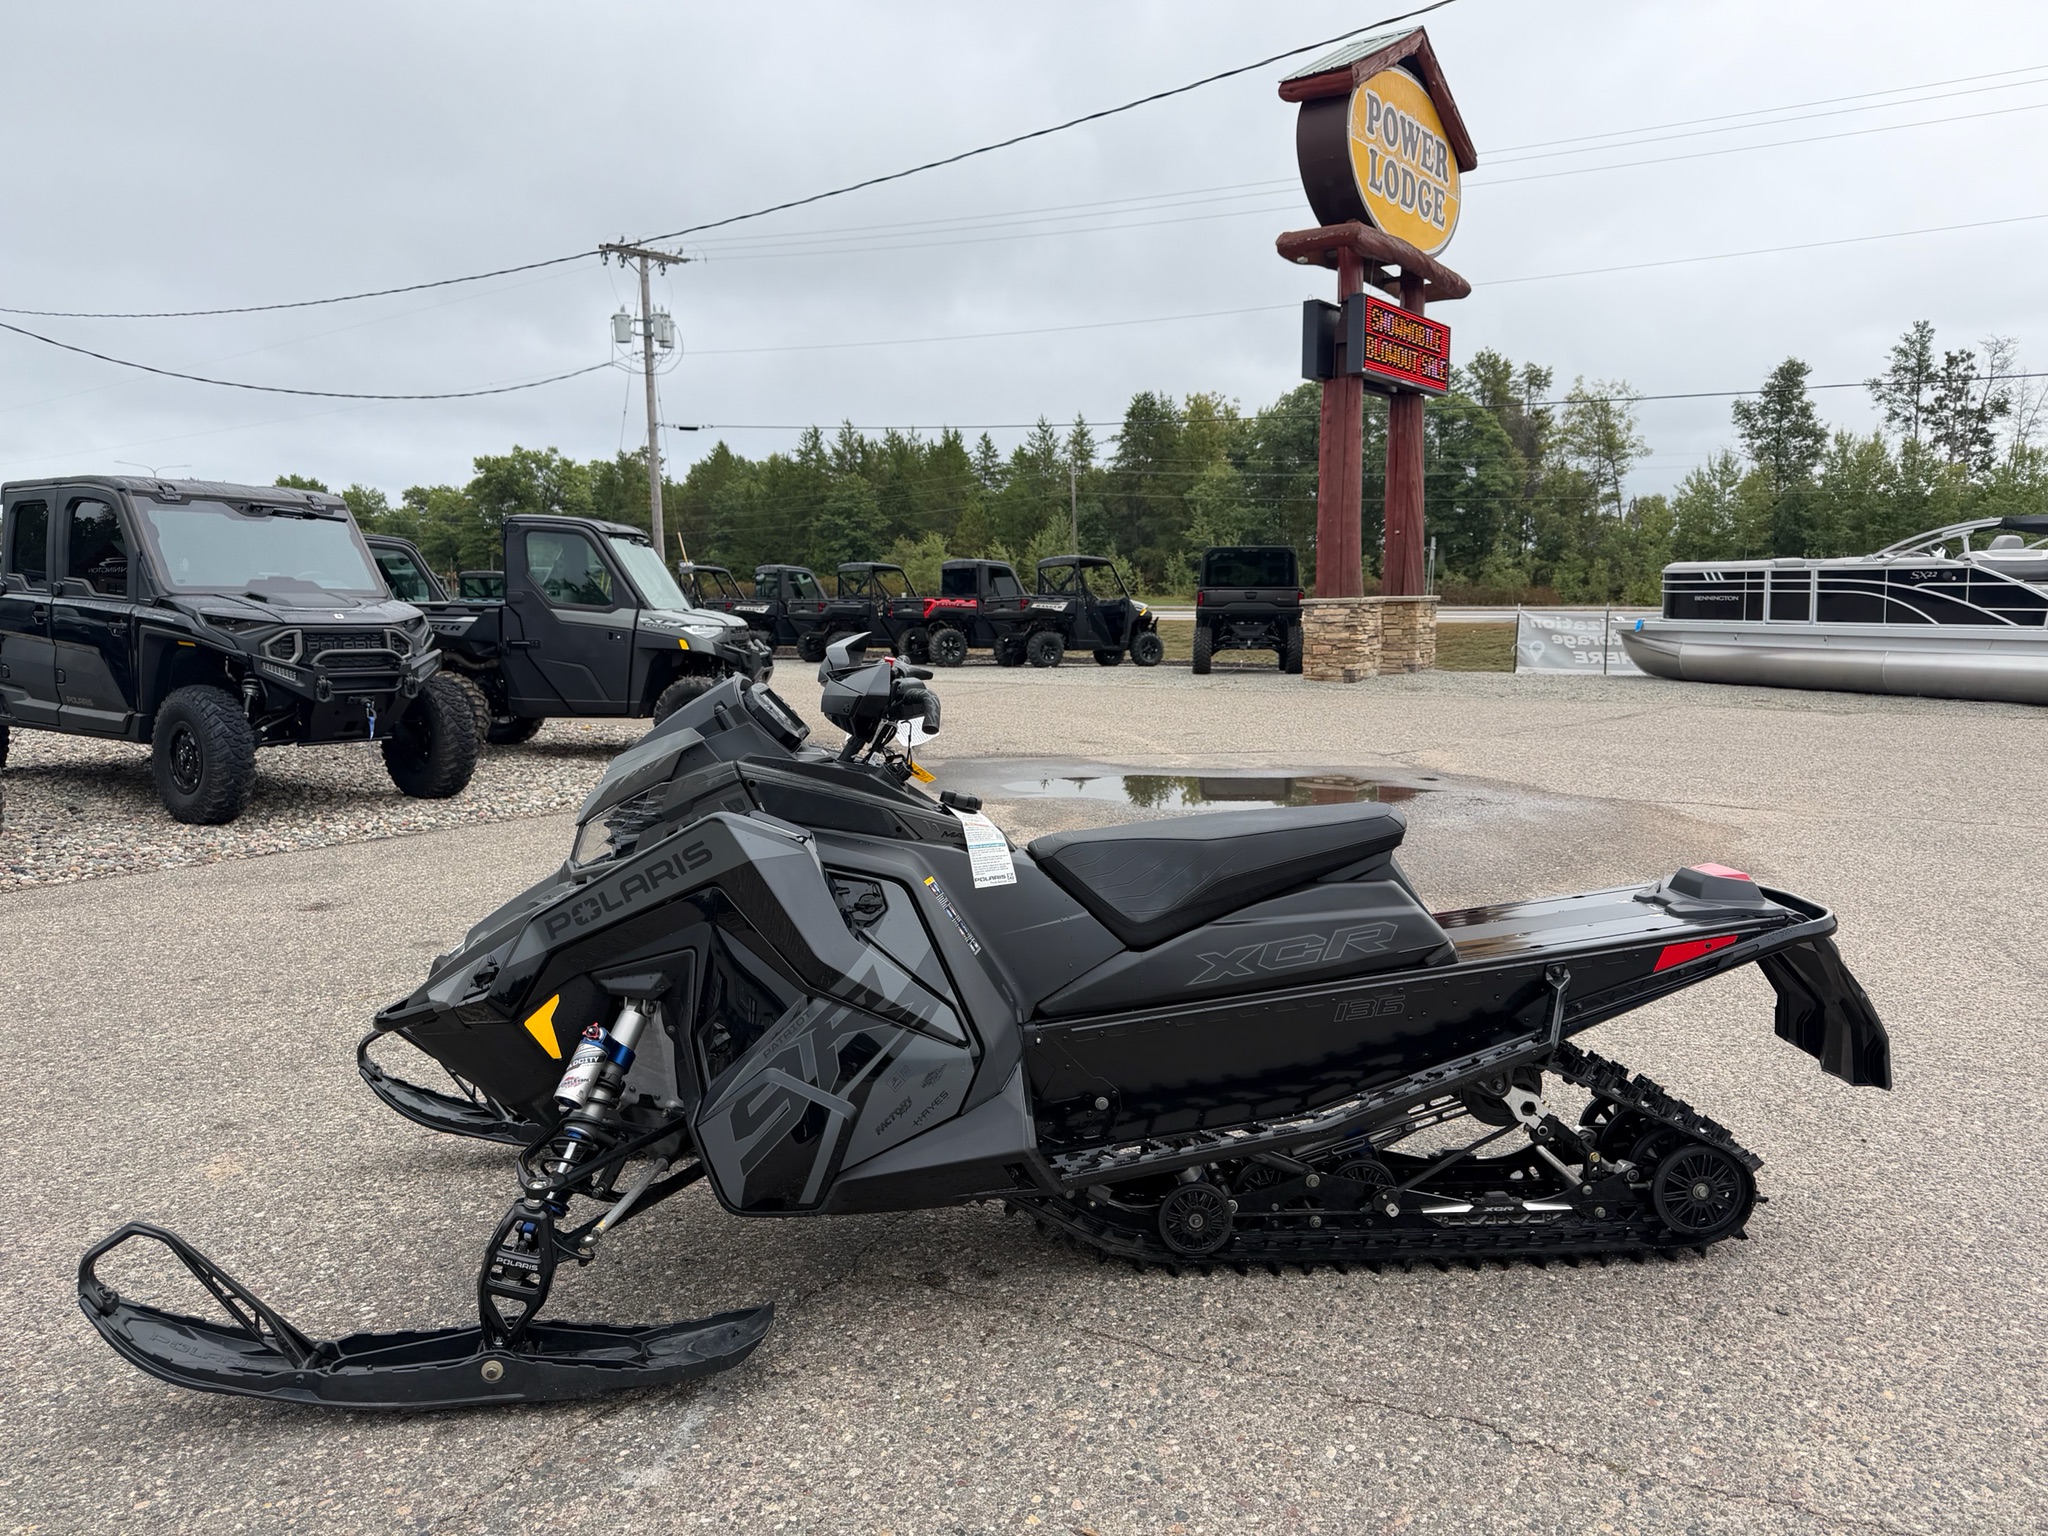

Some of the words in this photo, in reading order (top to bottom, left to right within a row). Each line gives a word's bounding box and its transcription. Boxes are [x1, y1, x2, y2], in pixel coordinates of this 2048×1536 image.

[1366, 92, 1449, 184] POWER
[1369, 148, 1446, 228] LODGE
[1371, 307, 1441, 352] SNOWMOBILE
[1365, 336, 1418, 373] BLOWOUT
[1421, 354, 1447, 380] SALE
[1910, 571, 1938, 580] SX22
[544, 840, 713, 941] POLARIS
[974, 873, 1007, 882] POLARIS
[1185, 921, 1398, 985] XCR
[1334, 995, 1406, 1022] 136
[762, 1010, 812, 1060] PATRIOT
[875, 1095, 912, 1136] FACTORY
[912, 1090, 949, 1127] HAYES
[496, 1256, 539, 1271] POLARIS
[149, 1331, 267, 1370] POLARIS
